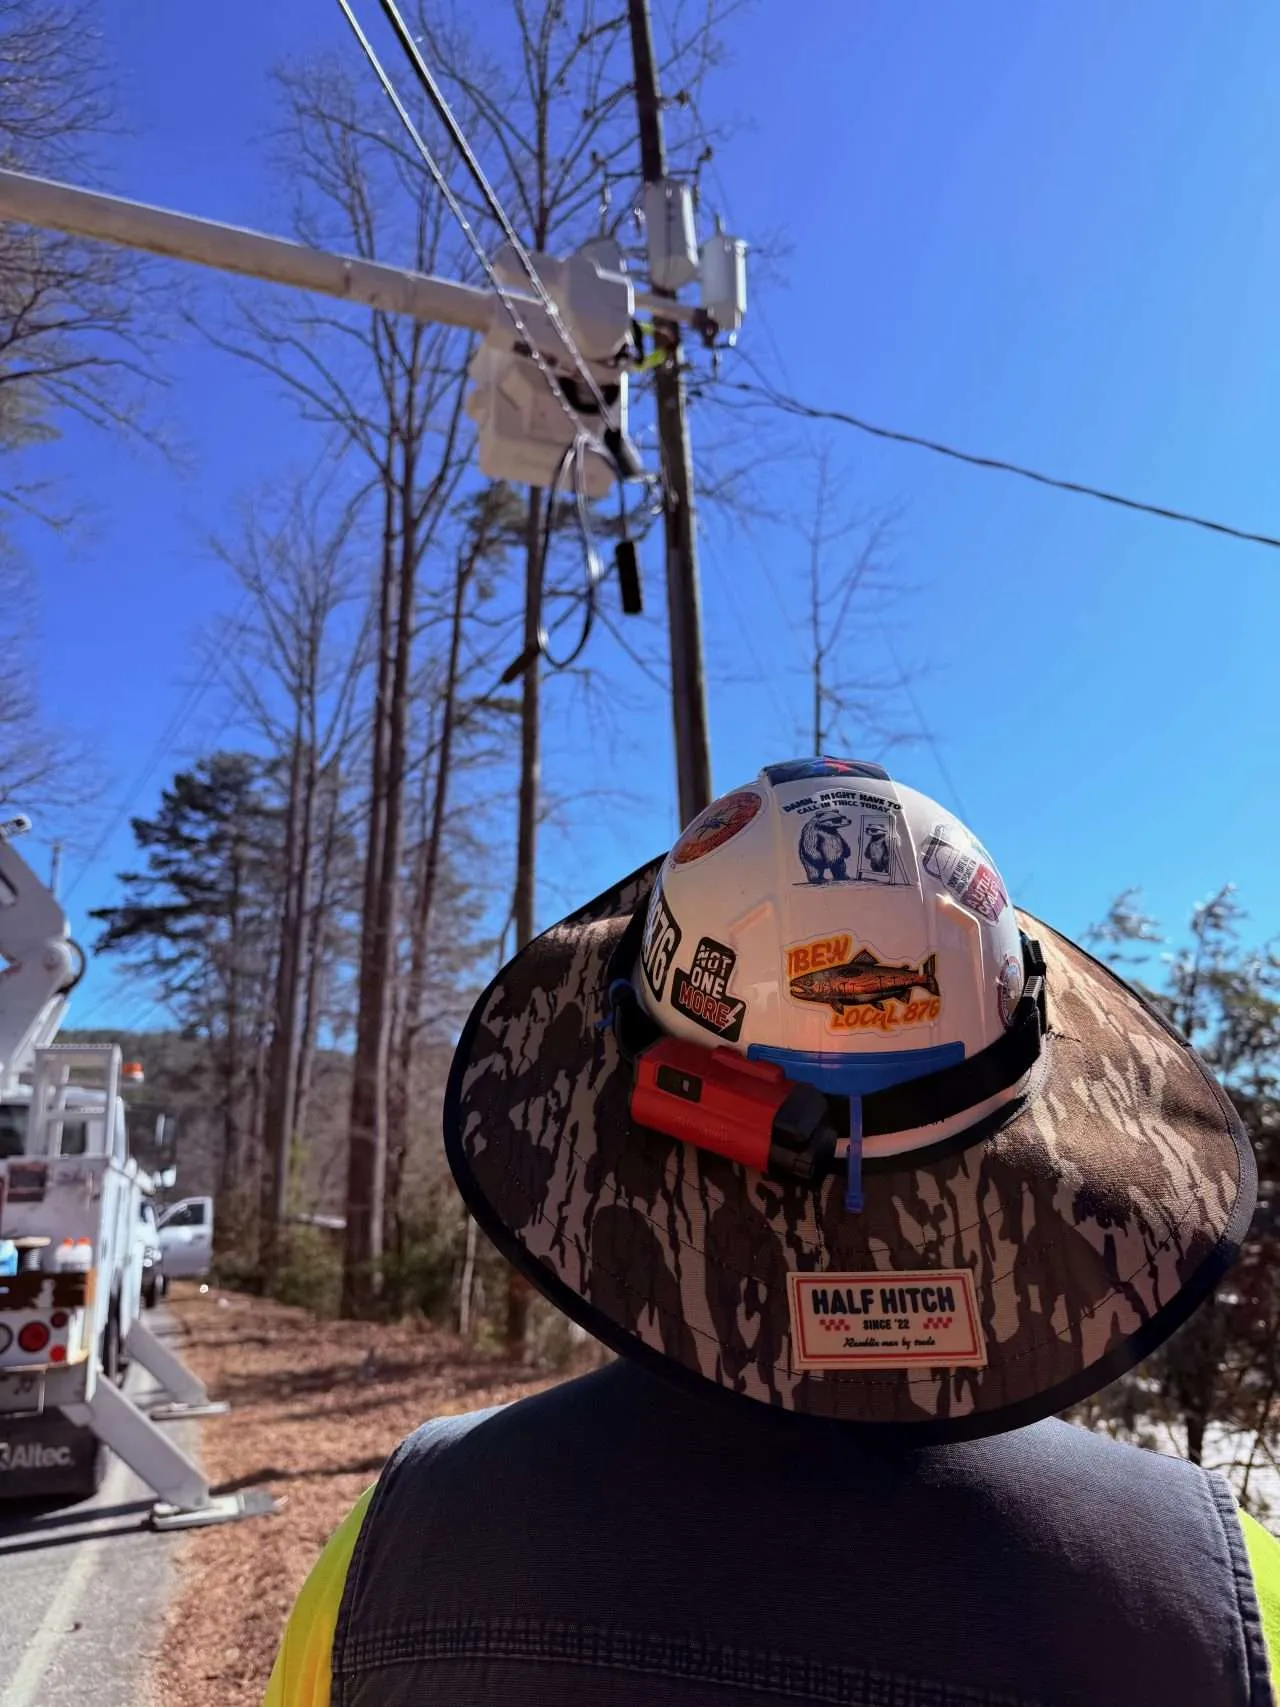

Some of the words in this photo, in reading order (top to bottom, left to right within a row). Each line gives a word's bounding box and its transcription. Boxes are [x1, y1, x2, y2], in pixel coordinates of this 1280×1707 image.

[797, 804, 820, 814] CALL
[820, 791, 856, 801] MIGHT
[860, 793, 885, 805] HAVE
[887, 800, 903, 810] TO
[973, 872, 991, 901] LITTLE
[695, 944, 732, 977] NOT
[788, 936, 848, 975] IBEW
[691, 966, 725, 999] ONE
[679, 981, 731, 1028] MORE
[831, 1002, 898, 1030] LOCAL
[904, 998, 940, 1022] 876
[812, 1288, 873, 1315] HALF
[880, 1286, 955, 1313] HITCH
[863, 1319, 892, 1330] SINCE
[894, 1318, 910, 1329] '22
[902, 1337, 912, 1350] by
[9, 1442, 70, 1469] Altec
